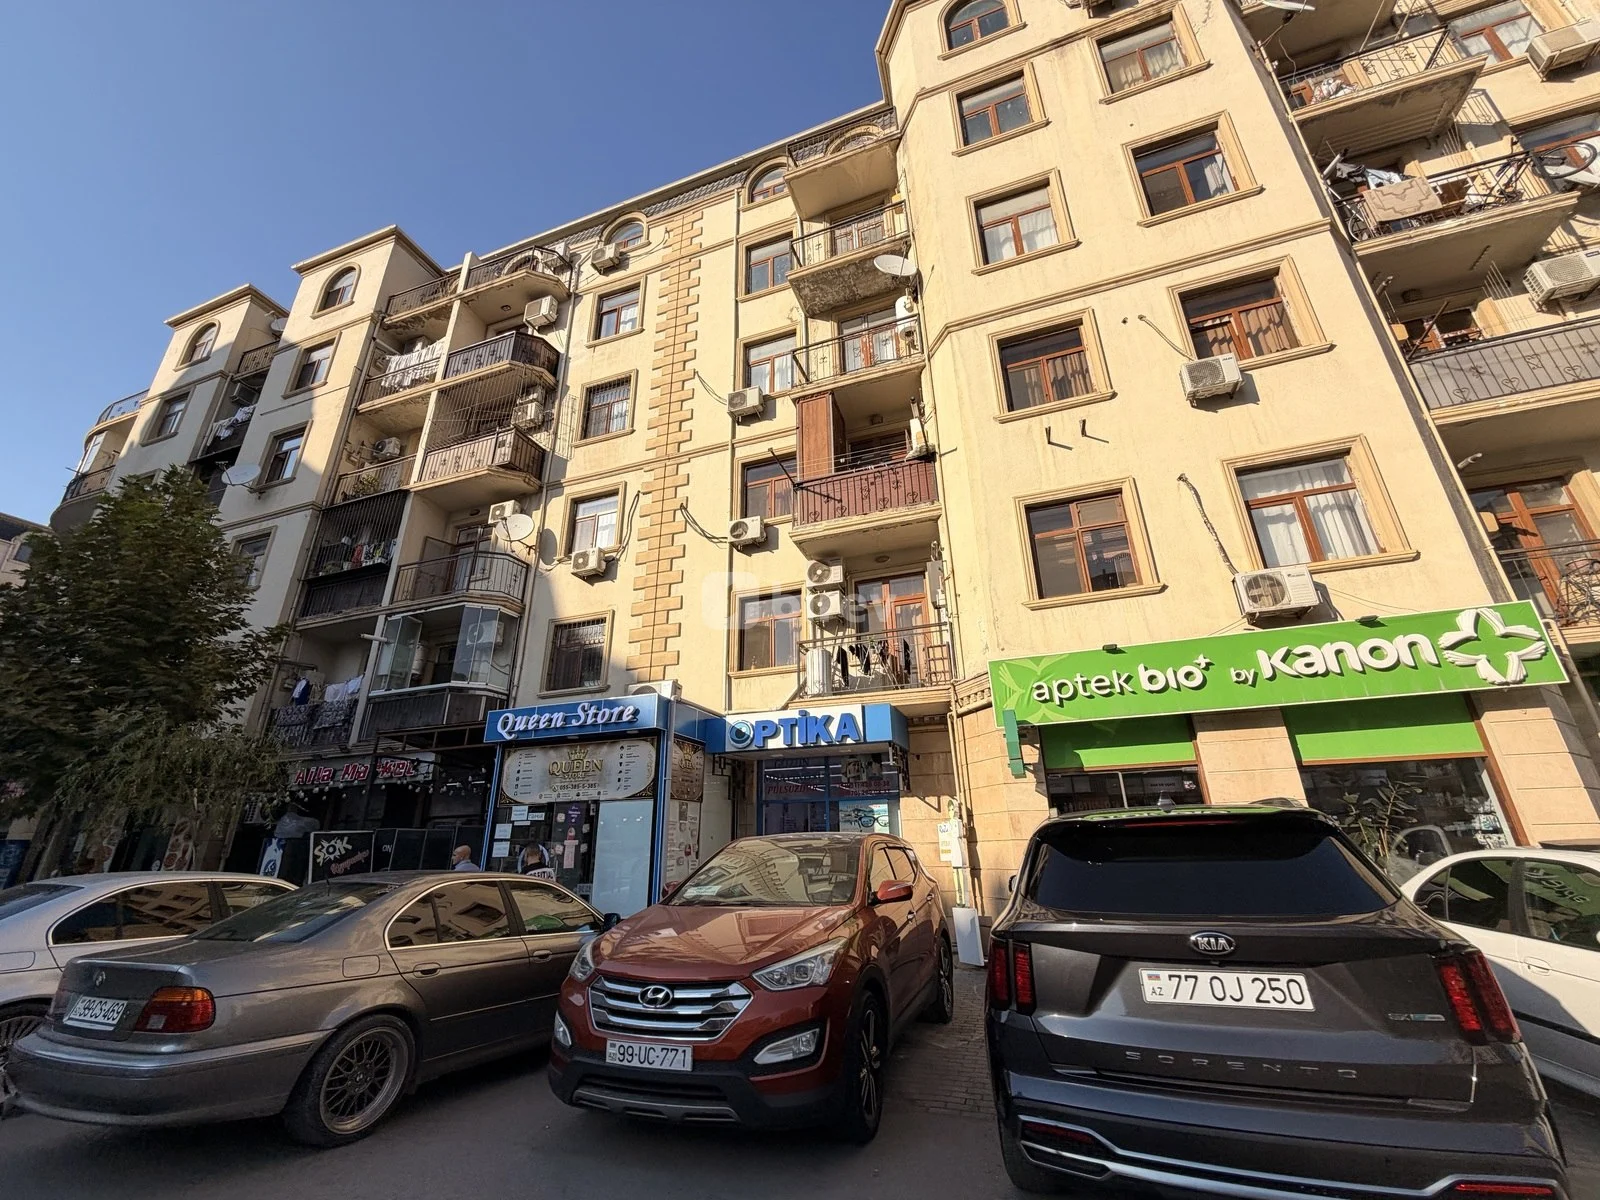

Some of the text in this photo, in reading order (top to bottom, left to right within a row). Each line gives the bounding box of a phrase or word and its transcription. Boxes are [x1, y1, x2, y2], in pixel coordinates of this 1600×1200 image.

[1032, 669, 1135, 706] aptek
[1230, 667, 1256, 685] by
[1256, 633, 1440, 680] Kanon
[497, 702, 636, 740] Queen Store
[549, 759, 604, 776] QUEEN
[1197, 937, 1230, 951] KIA
[1151, 986, 1164, 996] AZ
[1168, 974, 1305, 1005] 77 OJ 250
